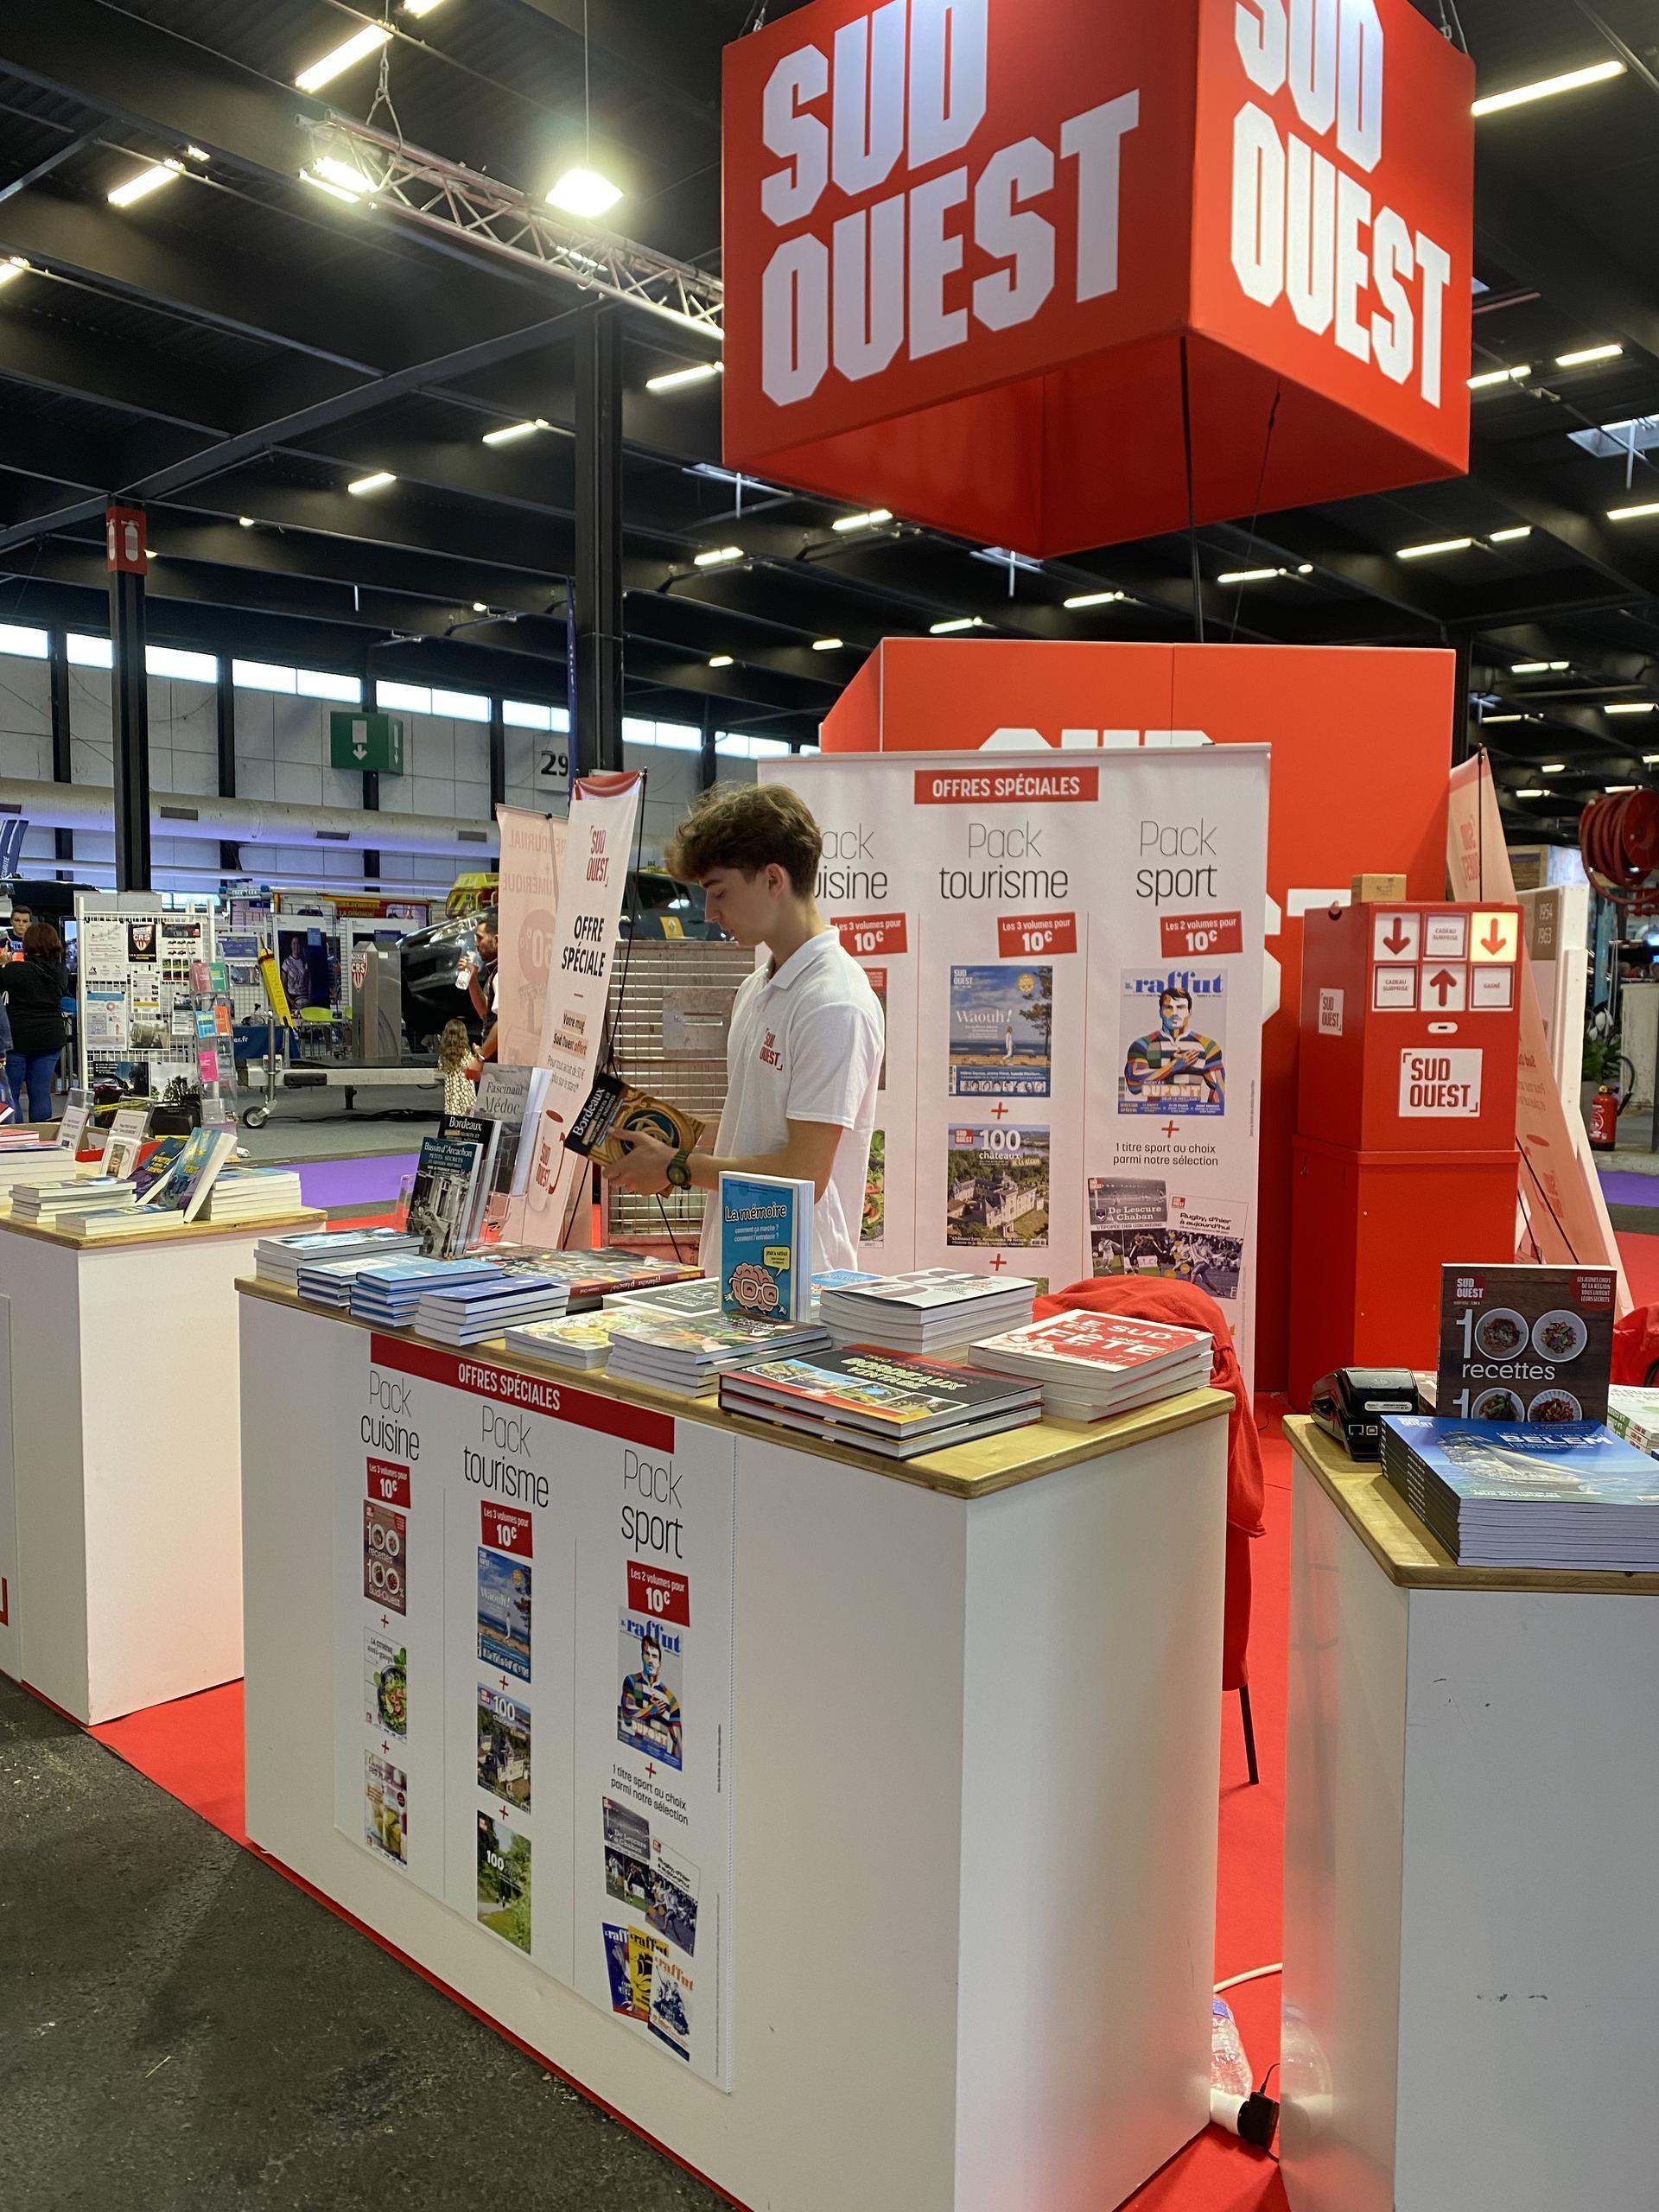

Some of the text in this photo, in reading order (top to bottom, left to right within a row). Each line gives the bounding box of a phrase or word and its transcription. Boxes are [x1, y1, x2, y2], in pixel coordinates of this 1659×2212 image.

[761, 0, 988, 226] SUD
[761, 89, 1140, 407] OUEST
[1231, 101, 1450, 409] OUEST
[932, 773, 1080, 798] OFFRES SPÉCIALES
[590, 830, 607, 855] SUD
[820, 823, 874, 860] ack
[968, 821, 1043, 858] Pack
[1140, 817, 1217, 856] Pack
[586, 856, 609, 884] OUEST
[939, 864, 1068, 899] tourisme
[1135, 864, 1217, 906] sport
[574, 915, 605, 943] OFFRE
[849, 919, 901, 931] 3 volumes pour
[1002, 918, 1071, 932] Les 3 volumes pour
[1165, 918, 1236, 931] Les 2 volumes pour
[1538, 927, 1552, 944] 1963
[351, 963, 365, 973] CRS
[562, 942, 606, 977] SPÉCIALE
[1135, 970, 1224, 994] raffut
[1322, 996, 1334, 1010] SUD
[1321, 1012, 1339, 1027] OUEST
[764, 1032, 776, 1048] SUD
[759, 1046, 781, 1066] OUEST
[1410, 1058, 1452, 1081] SUD
[486, 1081, 524, 1096] Fascinant
[1141, 1084, 1202, 1097] DUPONT
[1409, 1084, 1471, 1108] OUEST
[483, 1096, 520, 1115] Médoc
[572, 1087, 606, 1137] Bordeaux
[448, 1116, 483, 1132] Bordeaux
[979, 1128, 1021, 1151] 100
[1122, 1143, 1142, 1153] titre
[1144, 1143, 1171, 1154] sport
[1173, 1145, 1186, 1154] au
[1188, 1143, 1217, 1154] choix
[1113, 1154, 1218, 1166] parmi notre sélection
[724, 1201, 787, 1223] La mémoire
[1116, 1213, 1154, 1222] Chaban
[1123, 1205, 1162, 1214] Lescure
[1179, 1211, 1208, 1223] Rugby,
[734, 1226, 753, 1235] comment
[1187, 1219, 1230, 1231] aujourd'hui
[1456, 1287, 1484, 1299] OUEST
[1457, 1277, 1475, 1288] SUD
[1107, 1325, 1173, 1340] SUD
[841, 1357, 968, 1391] BORDEAUX
[846, 1366, 928, 1389] VINTAGE
[1462, 1363, 1555, 1381] recettes
[370, 1370, 411, 1418] Pack
[458, 1363, 561, 1411] OFFRES SPÉCIALES
[360, 1414, 420, 1461] cuisine
[481, 1404, 531, 1458] Pack
[1499, 1434, 1614, 1445] BELEM
[380, 1465, 397, 1478] volumes
[397, 1471, 408, 1481] pour
[463, 1446, 550, 1508] tourisme
[624, 1448, 683, 1509] Pack
[493, 1509, 497, 1518] 3
[497, 1510, 517, 1524] volumes
[517, 1516, 529, 1528] pour
[621, 1505, 683, 1559] sport
[368, 1547, 393, 1565] recettes
[631, 1567, 685, 1592] Les 2 volumes pour
[625, 1618, 682, 1654] raffut
[493, 1694, 516, 1722] 100
[631, 1719, 668, 1747] DUPONT
[617, 1765, 632, 1782] titre
[633, 1775, 653, 1796] sport
[654, 1788, 664, 1799] au
[665, 1792, 687, 1810] choix
[611, 1777, 689, 1826] parmi notre sélection
[486, 1849, 505, 1872] 100
[608, 1929, 629, 1943] raff
[658, 1956, 694, 1991] raffut
